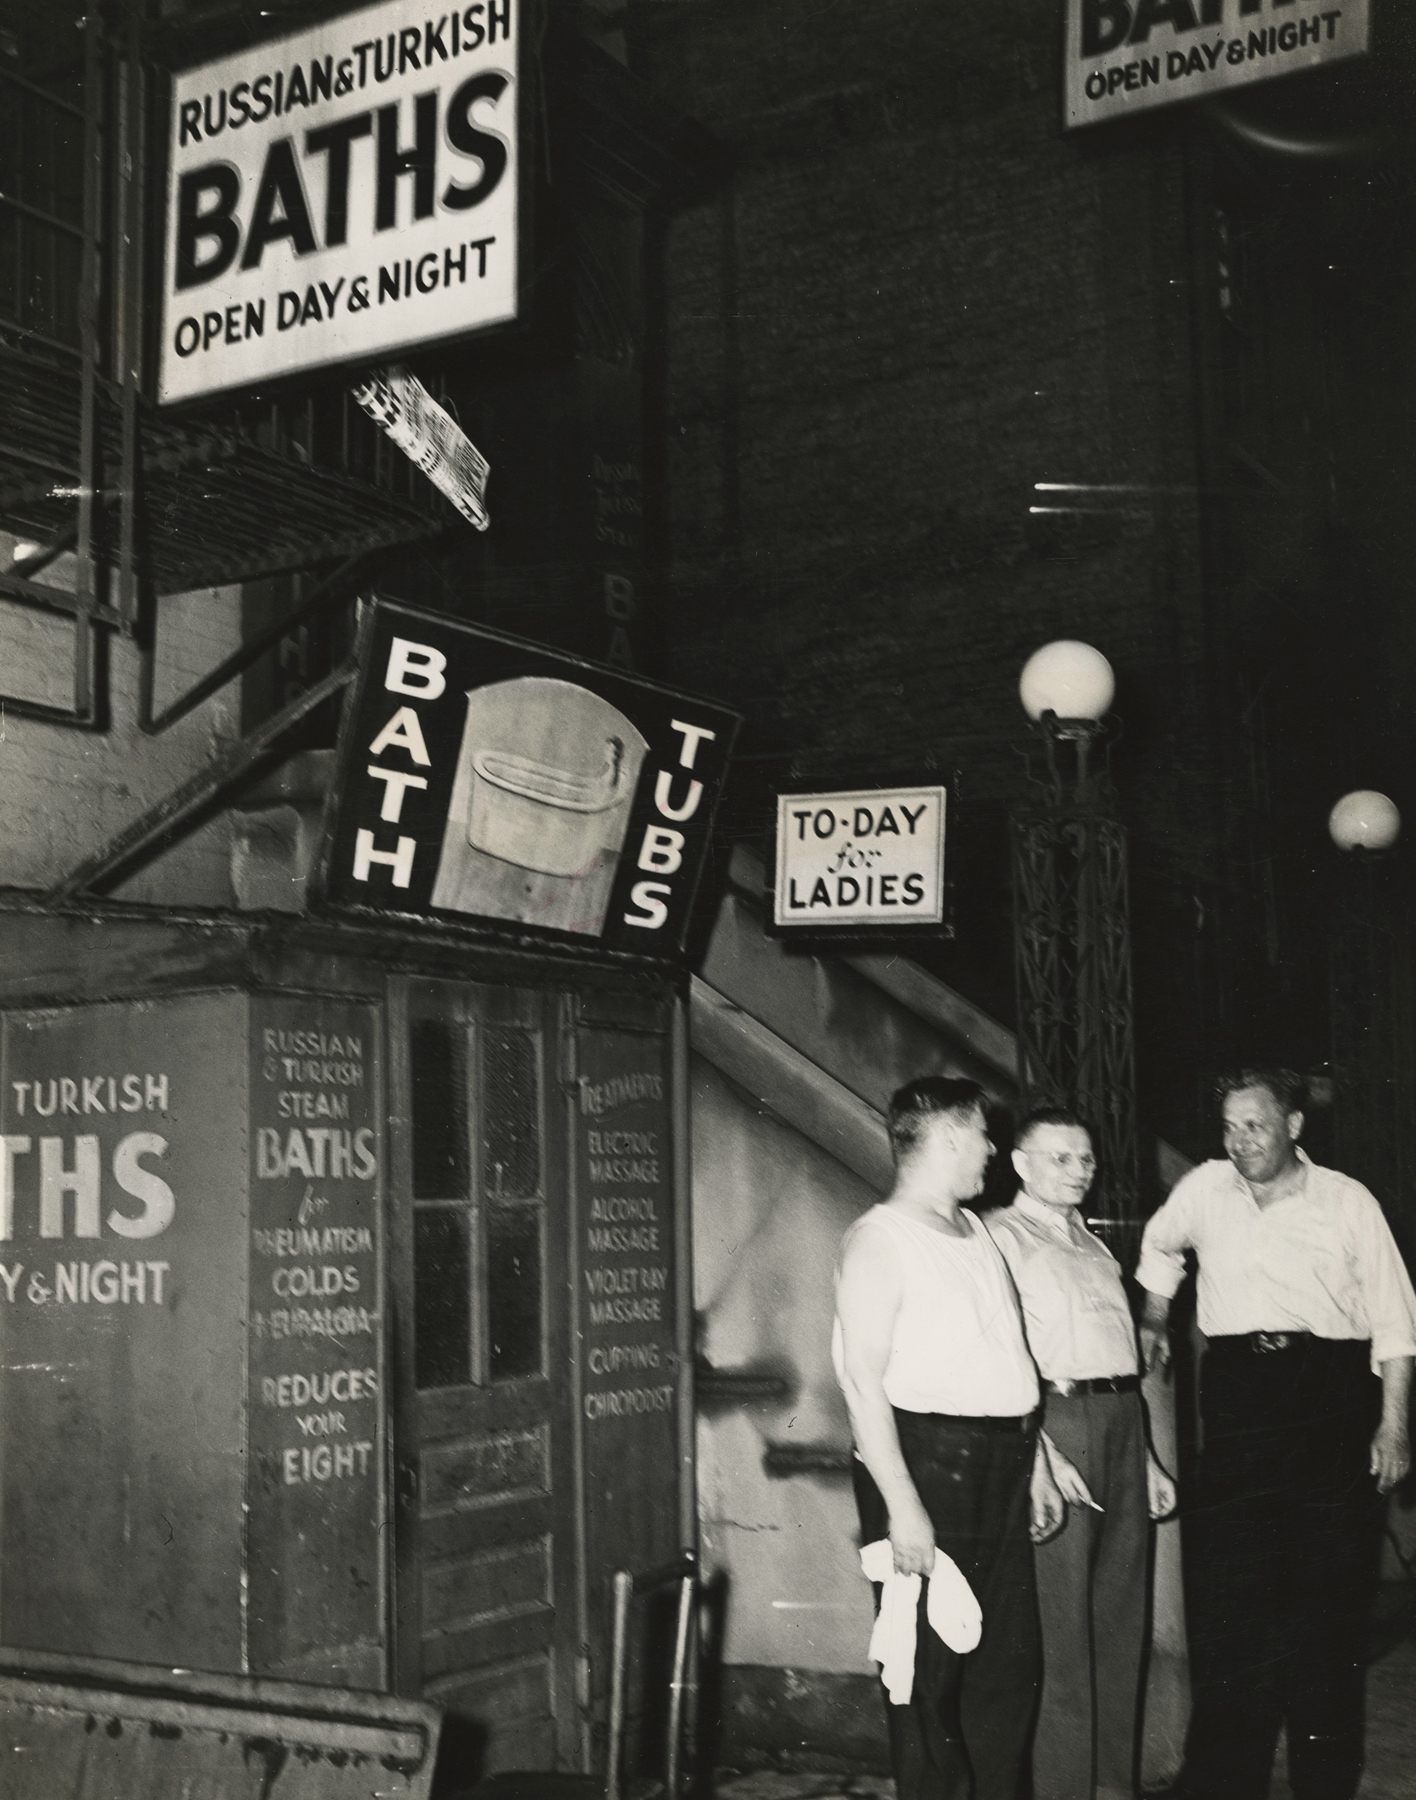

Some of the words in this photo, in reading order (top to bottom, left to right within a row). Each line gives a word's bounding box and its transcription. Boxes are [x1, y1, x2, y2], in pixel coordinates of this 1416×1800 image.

[1085, 55, 1160, 100] OPEN
[1248, 10, 1342, 60] NIGHT
[174, 70, 512, 294] BATHS
[174, 299, 265, 357] OPEN
[277, 277, 345, 331] DAY
[378, 236, 496, 304] NIGHT
[352, 636, 447, 888] BATH
[623, 718, 716, 930] TUBS
[827, 841, 883, 874] for
[789, 873, 925, 909] LADIES
[263, 1028, 363, 1059] RUSSIAN
[12, 1073, 169, 1117] TURKISH
[278, 1090, 349, 1119] STEAM
[256, 1127, 377, 1180] BATHS
[589, 1159, 660, 1184] MASSAGE
[590, 1196, 659, 1222] ALCOHOL
[588, 1226, 660, 1251] MASSAGE
[27, 1270, 51, 1304] &
[55, 1260, 170, 1304] NIGHT
[272, 1265, 361, 1297] COLDS
[584, 1267, 637, 1295] VIOLET
[589, 1297, 661, 1325] MASSAGE
[262, 1368, 379, 1407] REDUCES
[295, 1411, 348, 1437] YOUR
